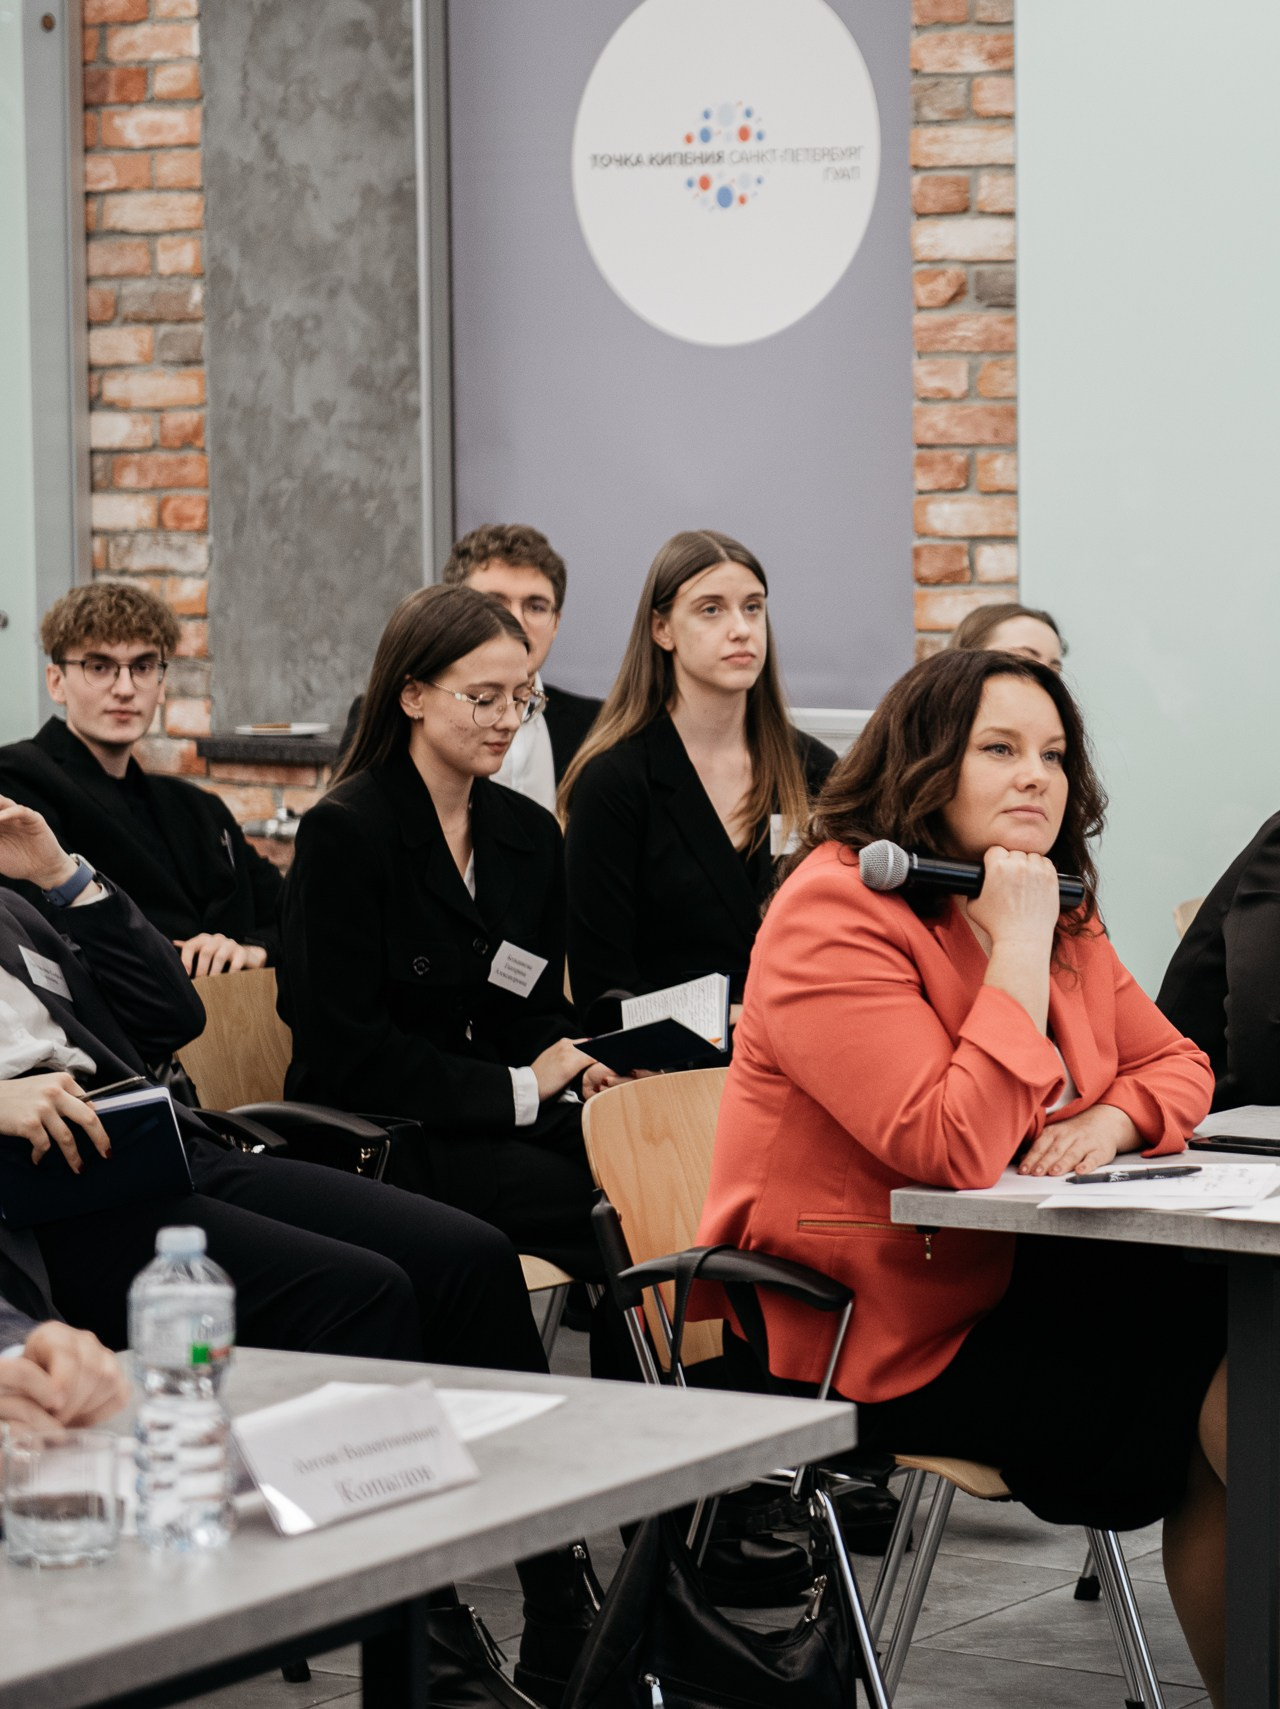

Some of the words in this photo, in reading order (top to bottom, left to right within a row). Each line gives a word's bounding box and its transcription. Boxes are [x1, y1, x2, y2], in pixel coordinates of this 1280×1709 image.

[591, 153, 644, 168] ТОЧКА
[649, 150, 725, 167] КИПЕНИЯ
[730, 146, 864, 165] САНКТ-ПЕТЕРБУРГ
